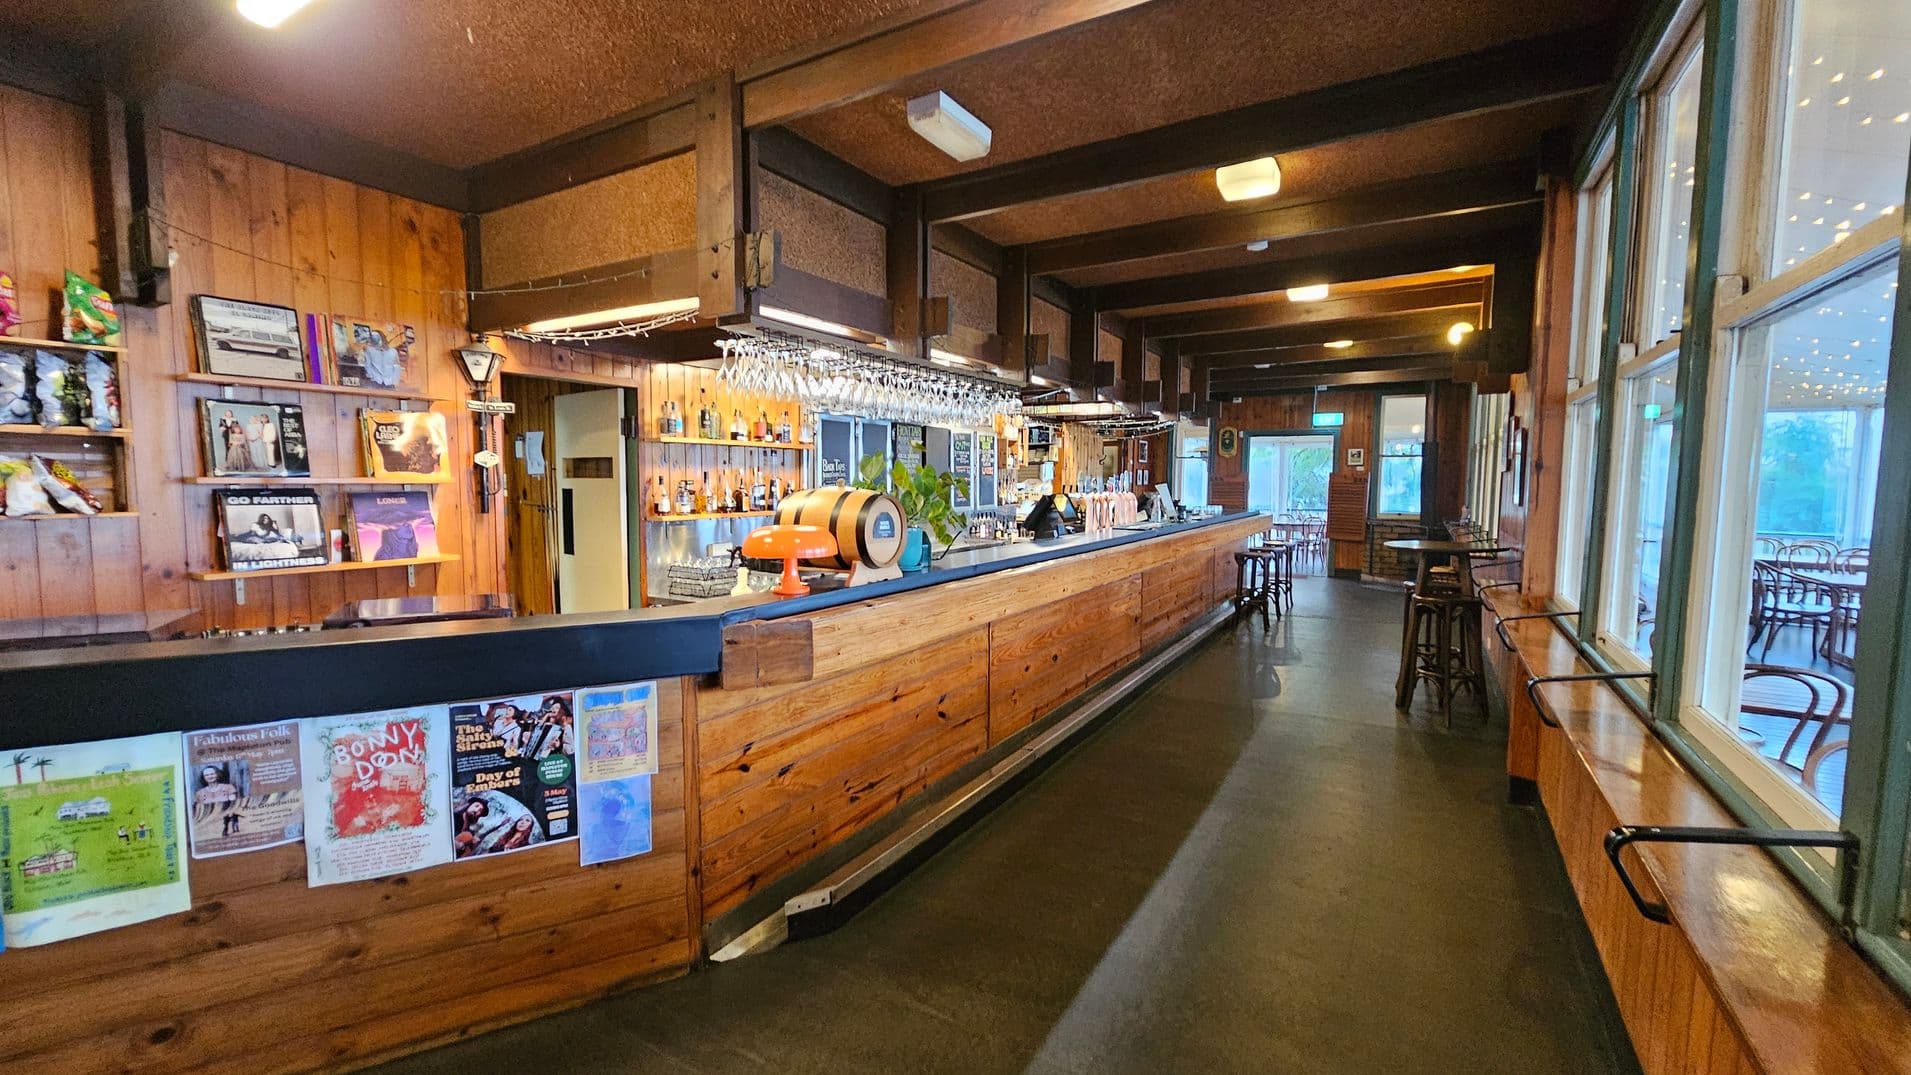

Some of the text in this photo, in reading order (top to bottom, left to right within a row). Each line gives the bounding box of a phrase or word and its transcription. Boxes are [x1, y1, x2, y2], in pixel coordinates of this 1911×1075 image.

[378, 425, 400, 433] CLEO
[227, 496, 251, 505] GO
[252, 496, 314, 504] FARTHER
[232, 561, 249, 570] IN
[249, 556, 325, 569] LIGHTNESS
[455, 724, 483, 734] The
[193, 725, 291, 747] Fabulous Folk
[455, 731, 493, 743] Salty
[208, 747, 225, 755] The
[274, 739, 291, 747] Pub
[334, 722, 418, 765] BONNY
[456, 740, 504, 752] Sirens
[355, 743, 421, 780] DOON
[475, 767, 521, 783] Day of
[465, 778, 521, 793] Embers
